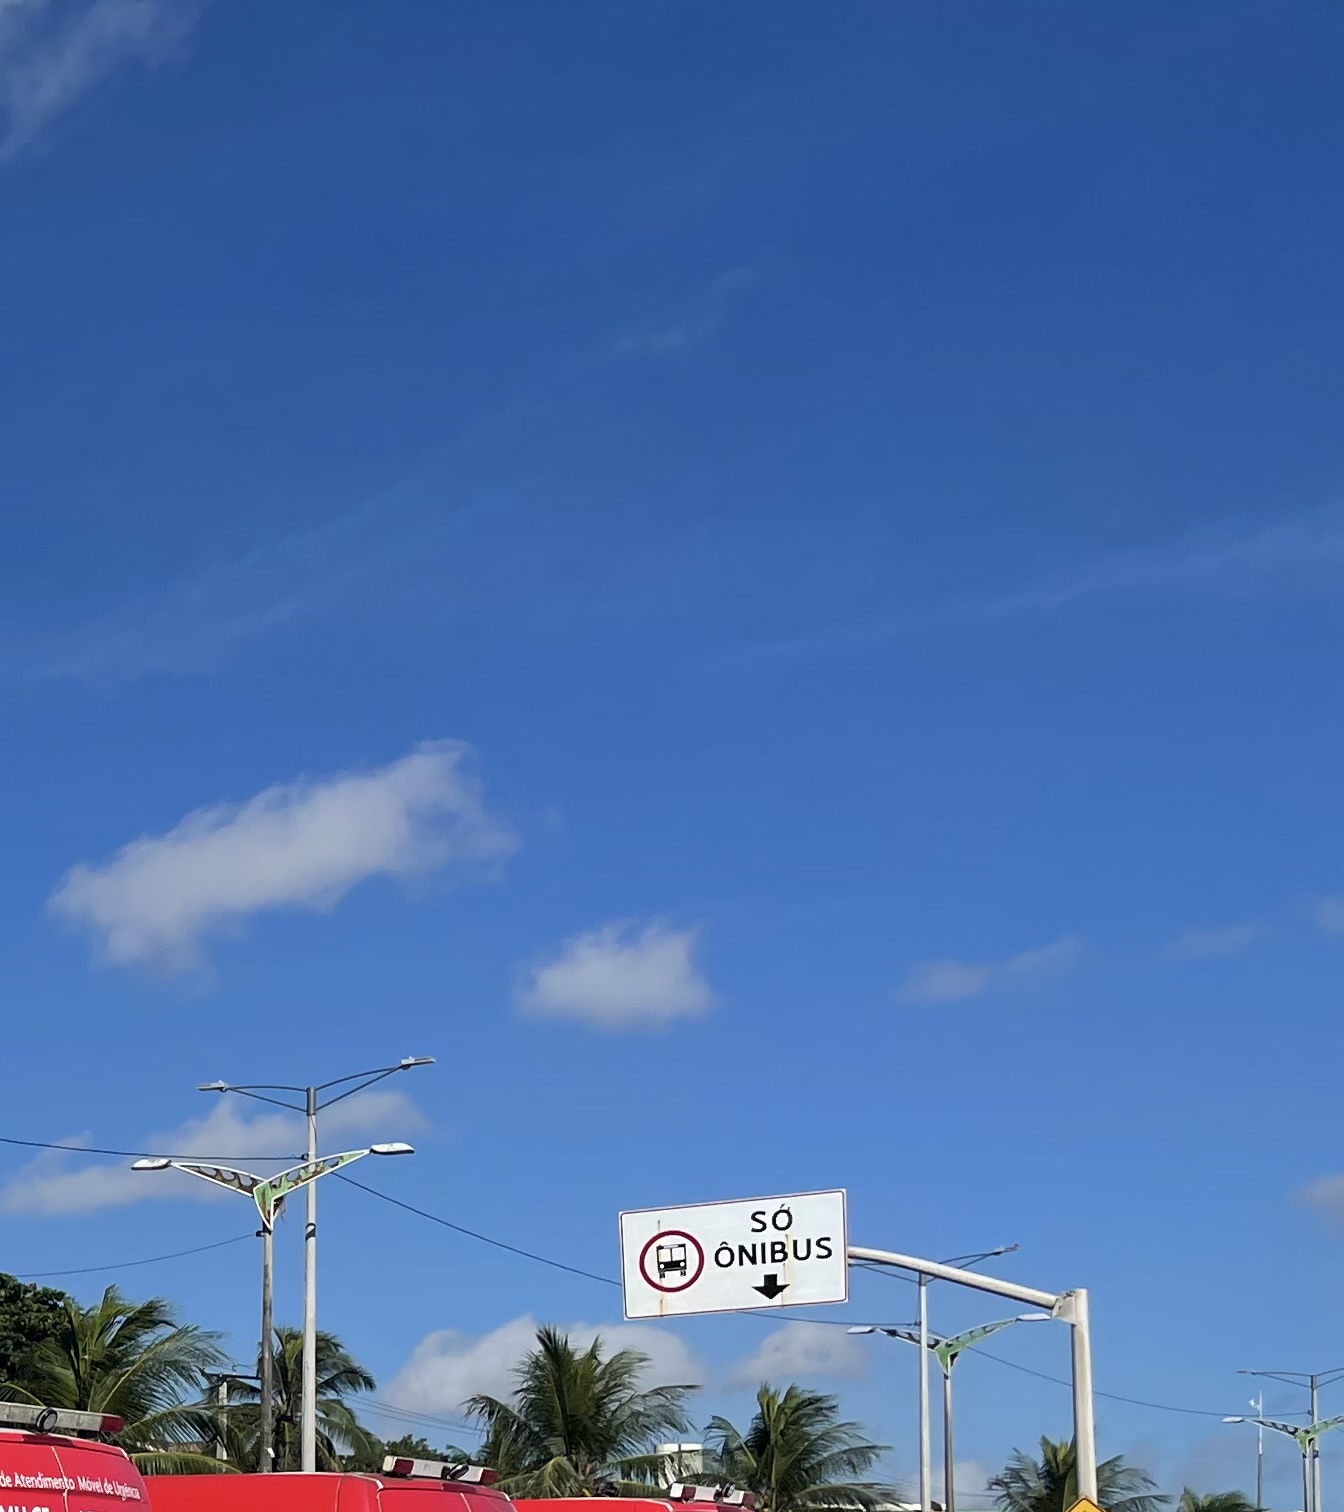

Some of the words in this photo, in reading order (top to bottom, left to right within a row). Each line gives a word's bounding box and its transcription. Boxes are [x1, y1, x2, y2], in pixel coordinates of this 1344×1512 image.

[750, 1203, 793, 1233] SÓ
[714, 1236, 833, 1268] ÔNIBUS
[14, 1471, 76, 1490] Atendimento
[104, 1478, 114, 1494] de
